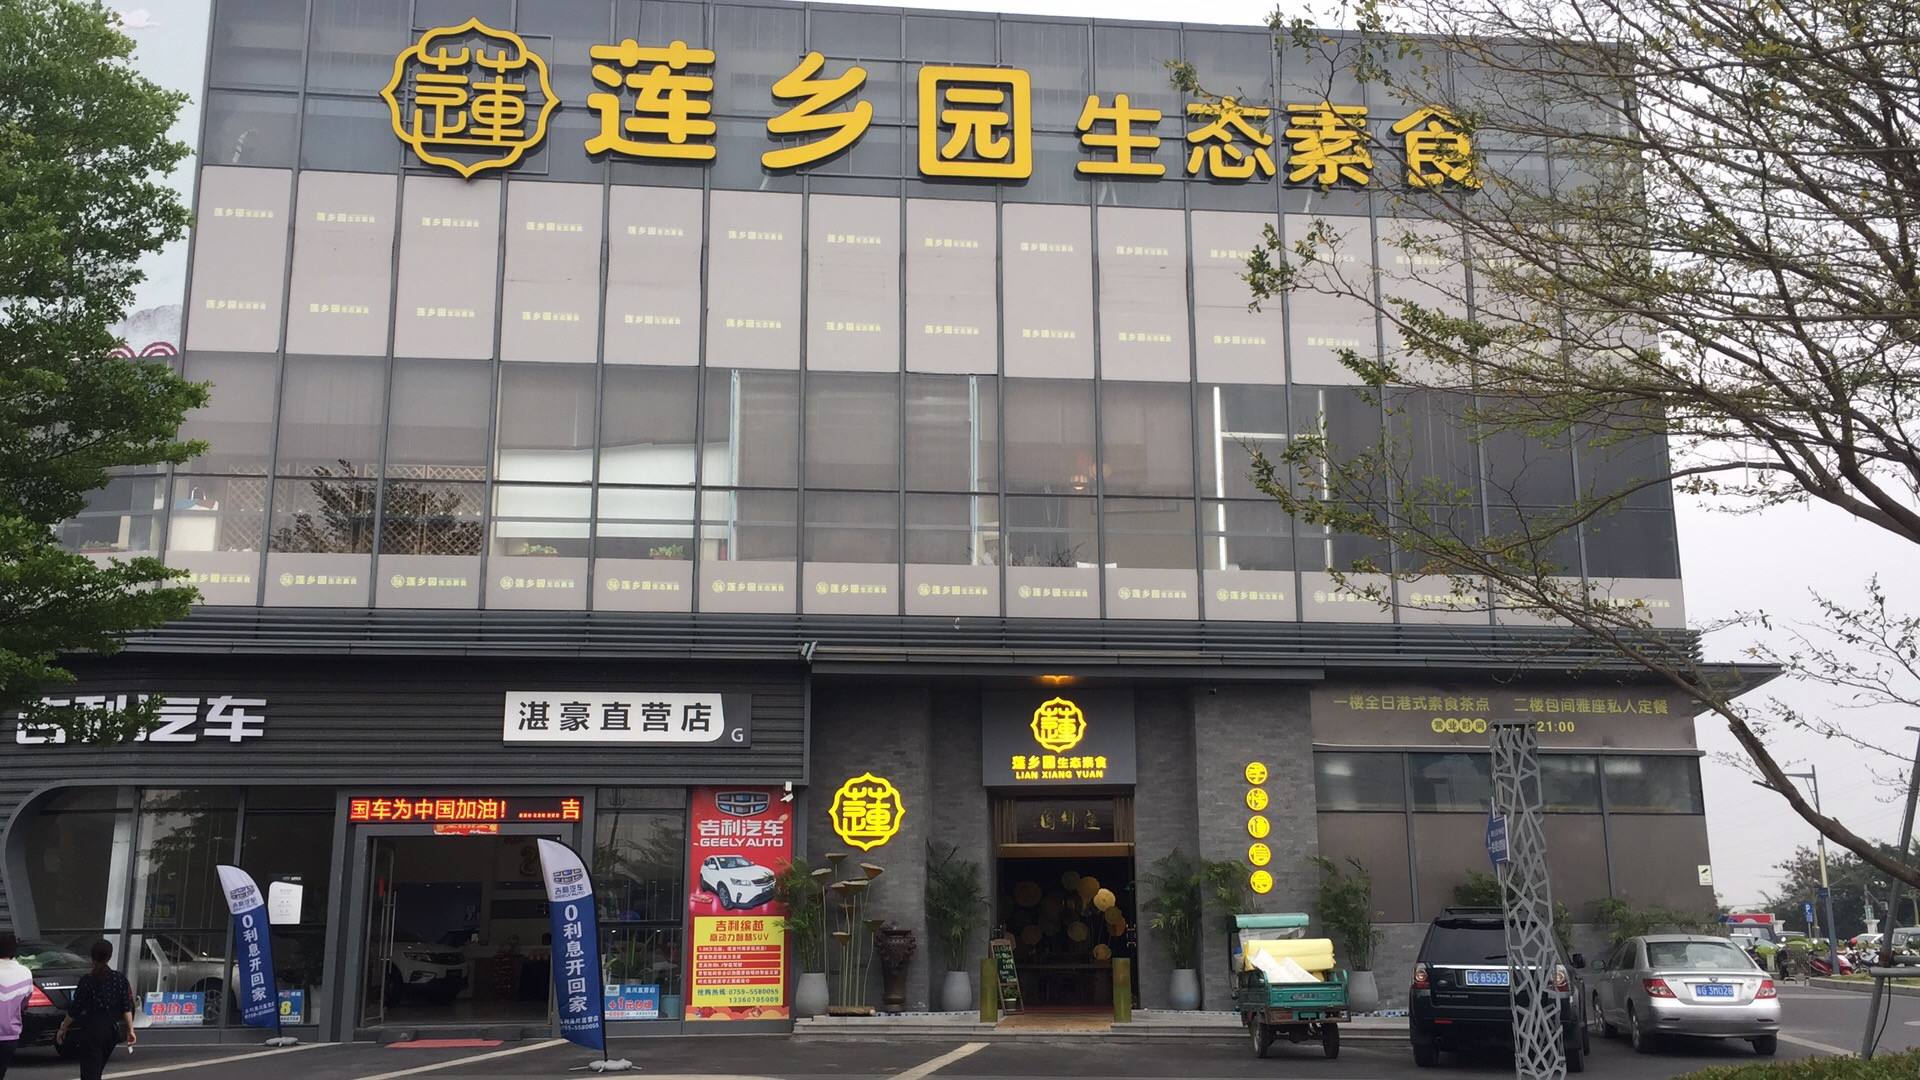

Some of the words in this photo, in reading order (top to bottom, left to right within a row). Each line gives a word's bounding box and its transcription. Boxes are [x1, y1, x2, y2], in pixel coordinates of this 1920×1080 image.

[584, 38, 1033, 180] 莲乡园
[1075, 93, 1485, 190] 生态素食
[1334, 695, 1490, 711] 一楼全日港式素食茶点
[1514, 698, 1668, 715] 二楼包间雅座私人定餐
[518, 701, 713, 733] 湛豪直营店
[731, 728, 745, 743] G
[1012, 755, 1107, 769] 莲乡园生态素食
[1016, 771, 1039, 779] LIAN
[1042, 770, 1072, 779] XIANG
[1076, 770, 1103, 779] YUAN
[700, 820, 784, 837] 吉利汽车
[700, 838, 743, 847] GEELY
[746, 838, 784, 847] AUTO
[242, 915, 268, 1002] 0利息开回家
[563, 904, 588, 1013] 0利息开回家
